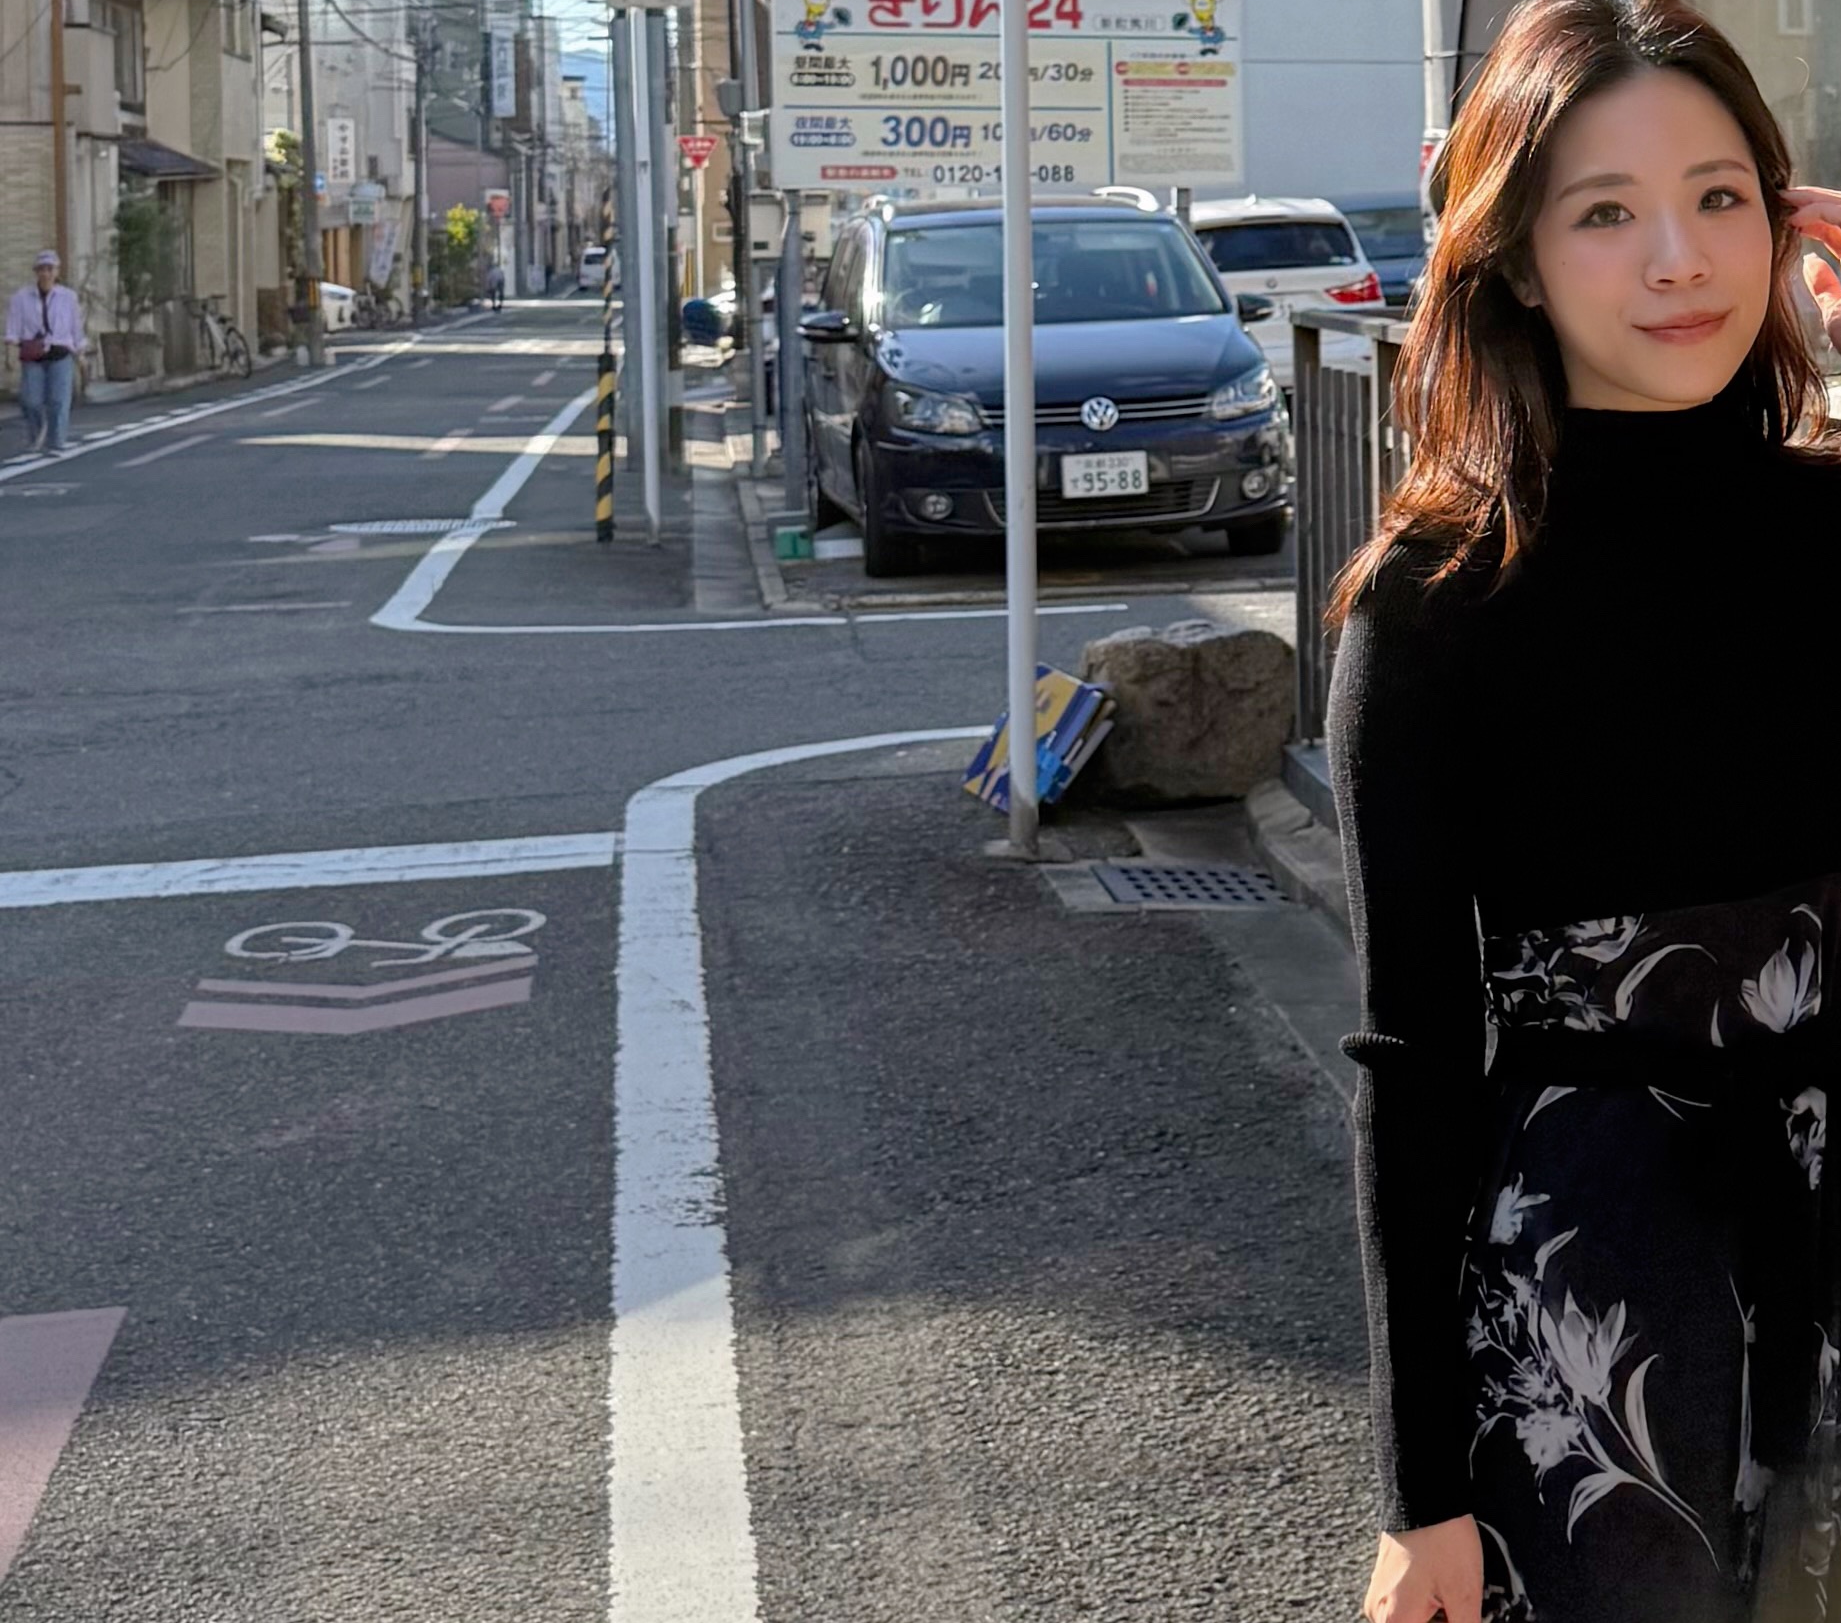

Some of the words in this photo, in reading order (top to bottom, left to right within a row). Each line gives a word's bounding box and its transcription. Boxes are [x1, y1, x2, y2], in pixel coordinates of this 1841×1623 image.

[871, 55, 971, 90] 1,000円
[979, 62, 1095, 82] 20円/30分
[881, 115, 972, 148] 300円
[932, 164, 1075, 183] 0120-1-088
